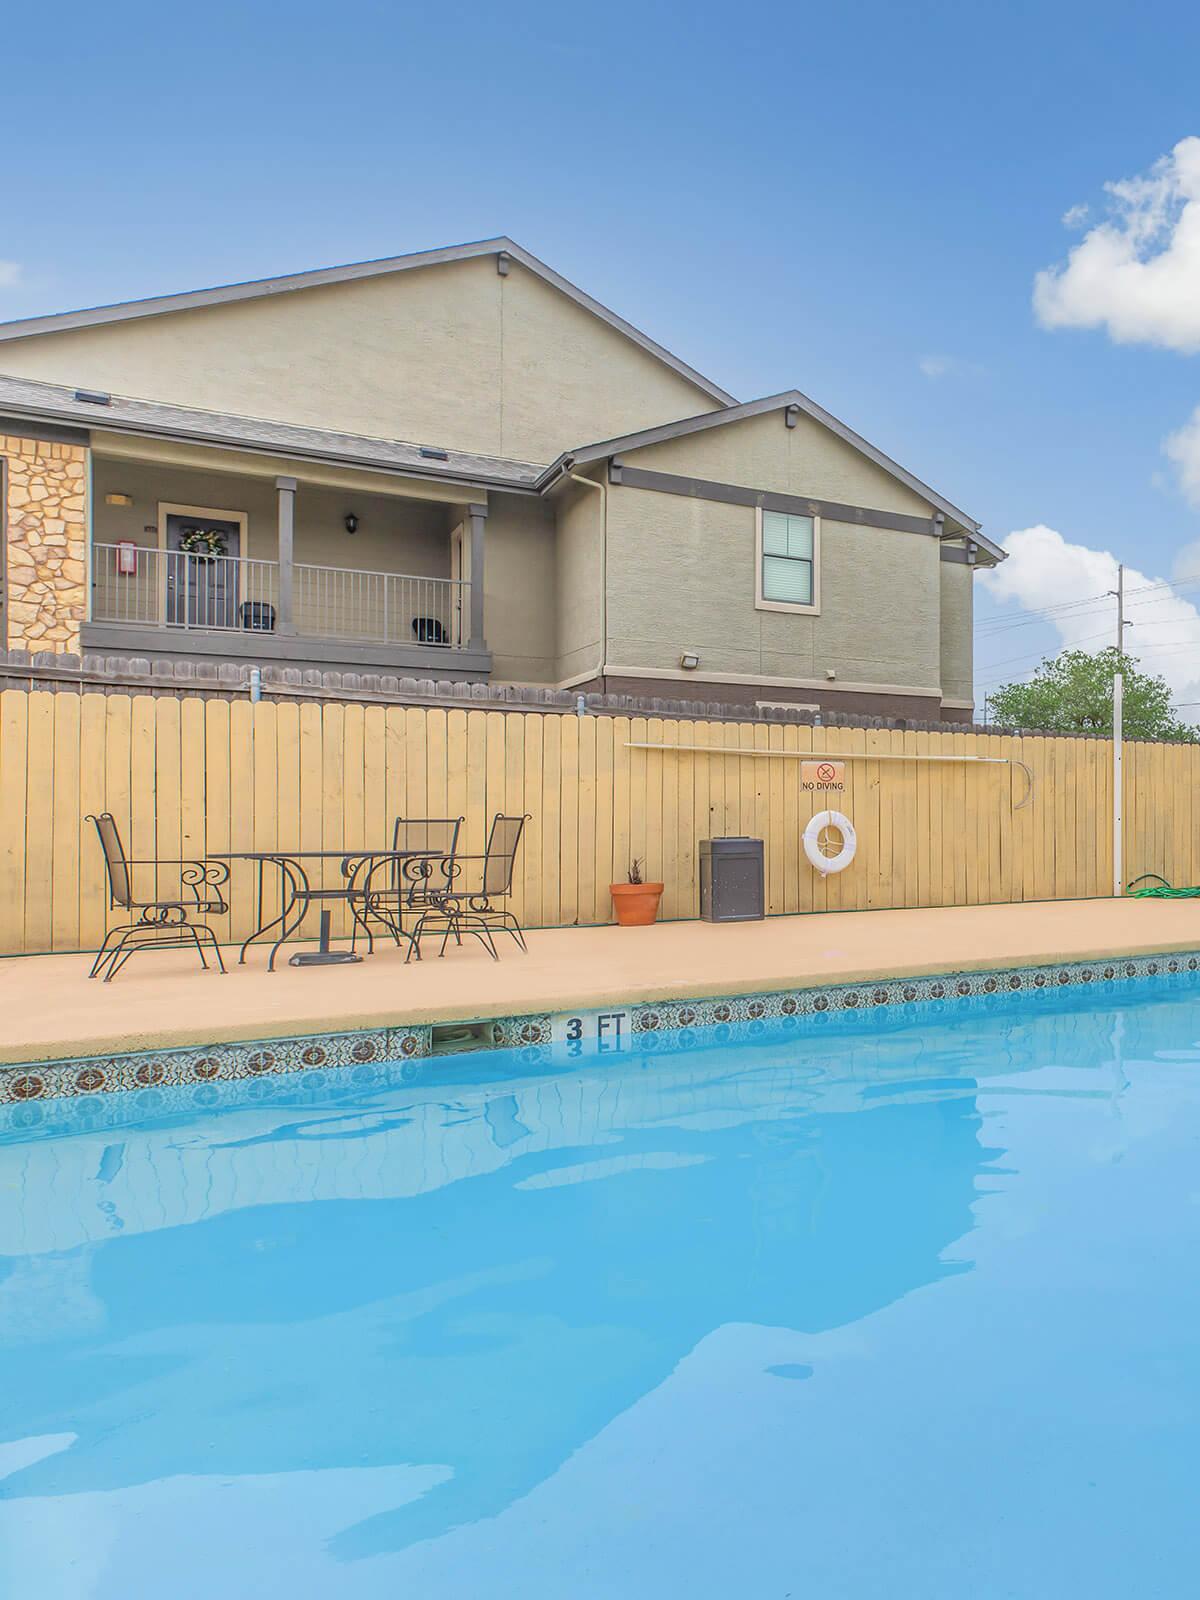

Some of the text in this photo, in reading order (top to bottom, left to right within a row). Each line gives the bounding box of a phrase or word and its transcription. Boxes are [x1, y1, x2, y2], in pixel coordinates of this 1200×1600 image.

[803, 782, 843, 790] NO DIVING
[566, 1012, 626, 1040] 3 FT
